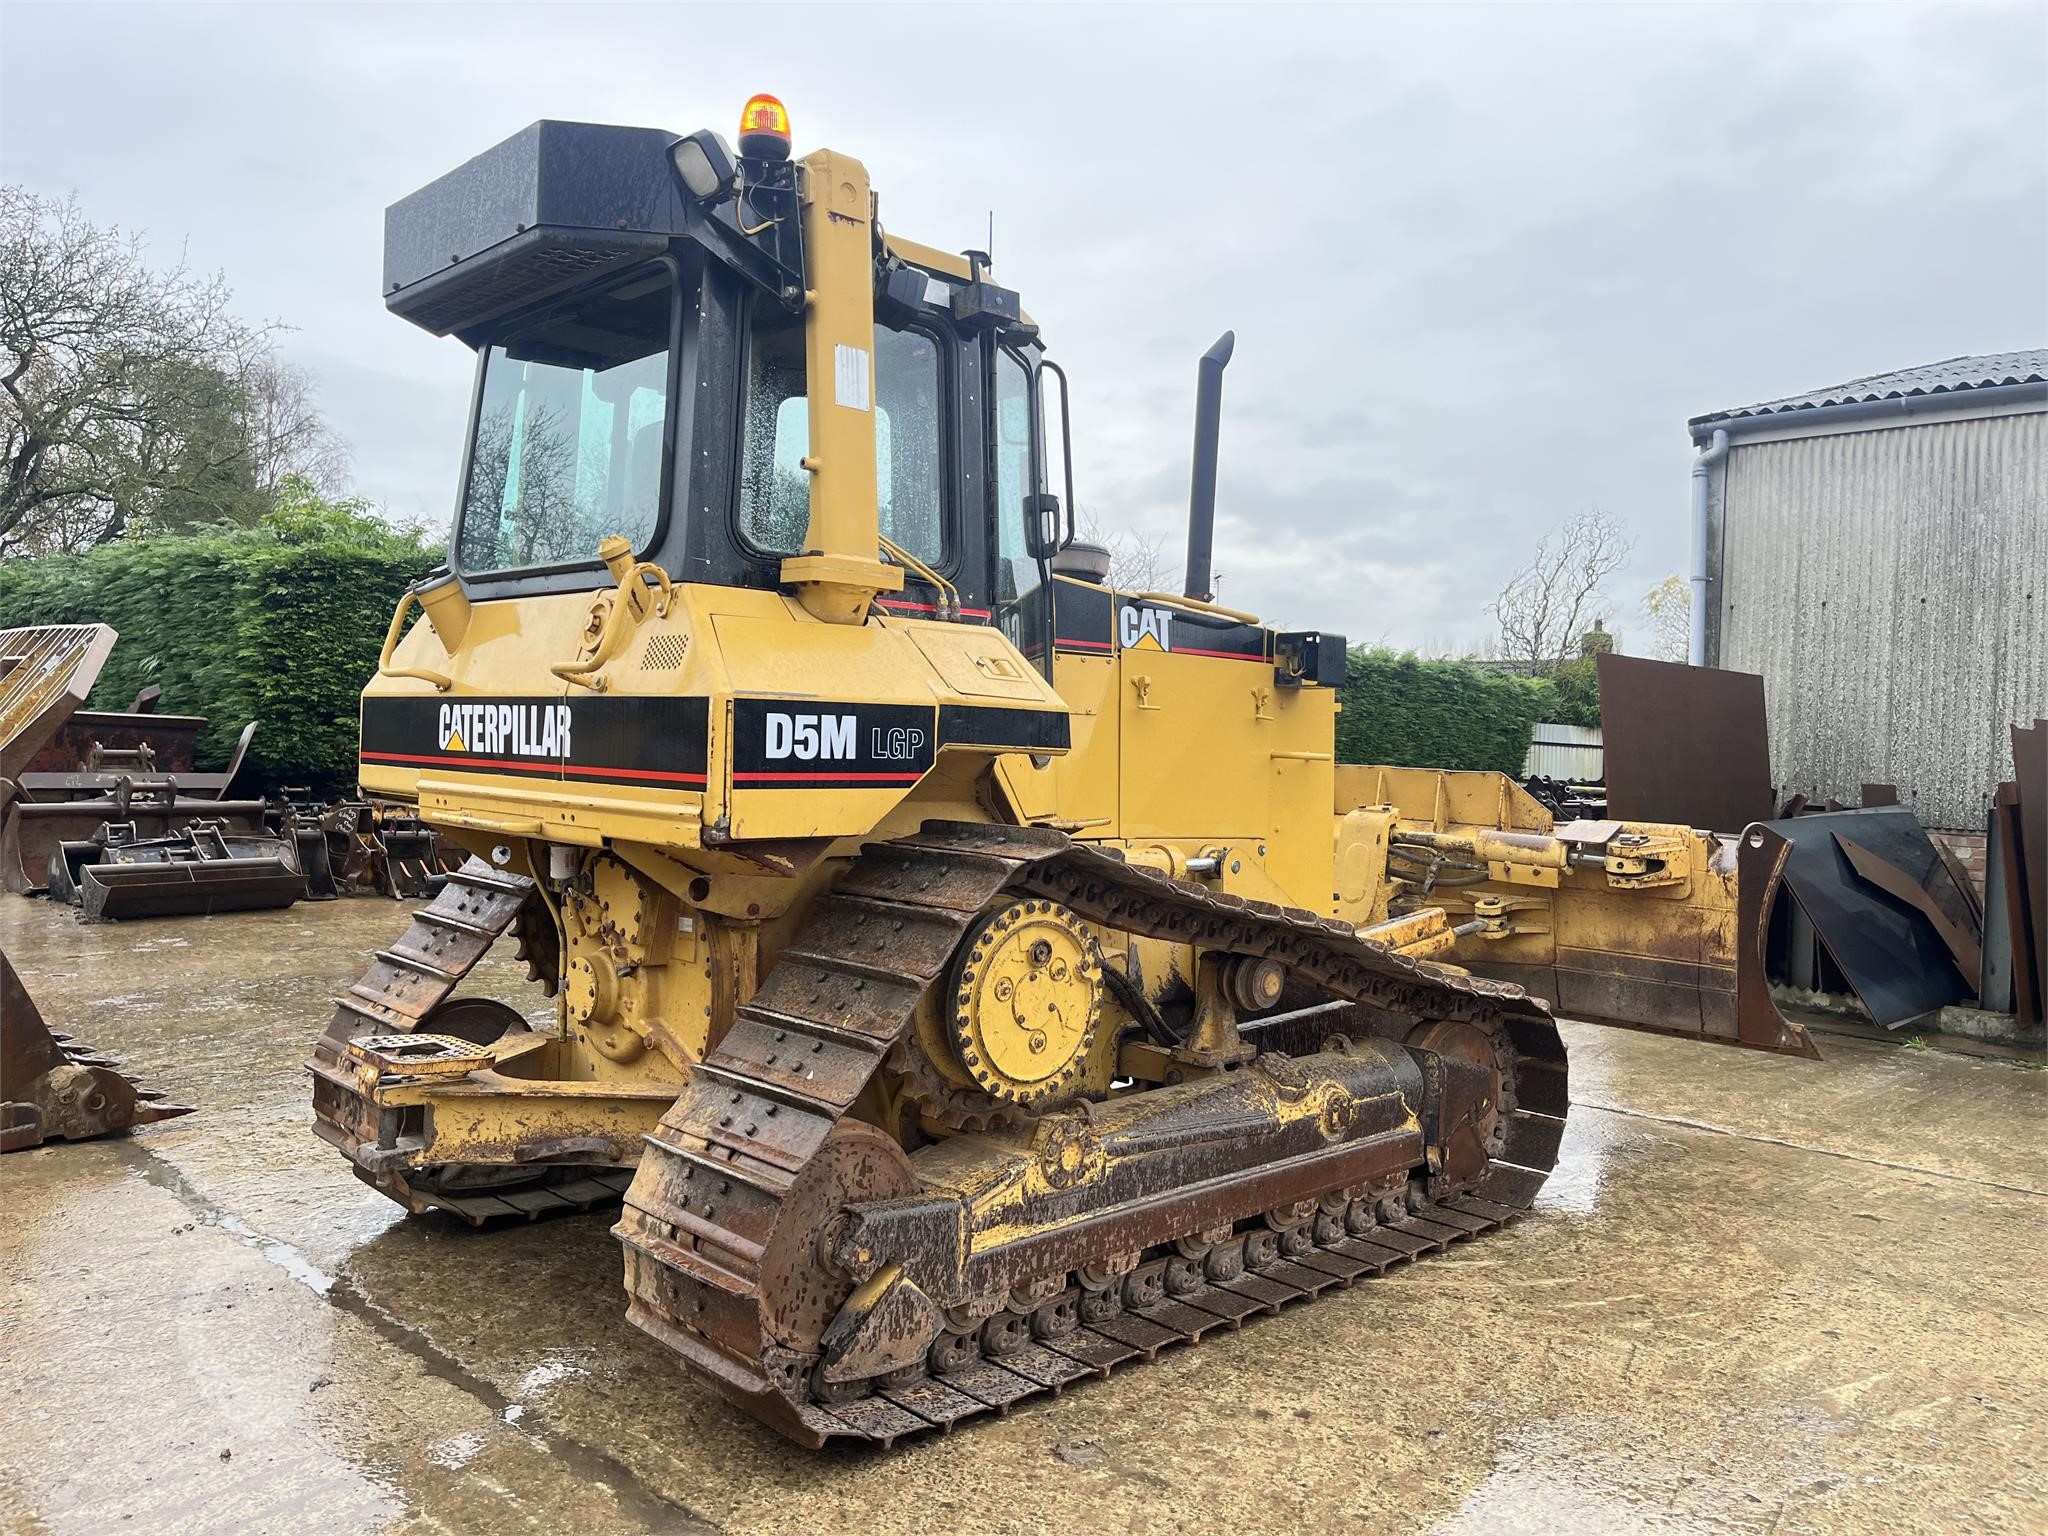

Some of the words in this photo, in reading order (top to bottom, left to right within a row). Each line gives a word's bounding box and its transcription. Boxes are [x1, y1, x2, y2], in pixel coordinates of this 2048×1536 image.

[1120, 605, 1172, 652] CAT
[438, 703, 572, 758] CATERPILLAR
[765, 713, 857, 760] D5M
[871, 727, 924, 760] LGP
